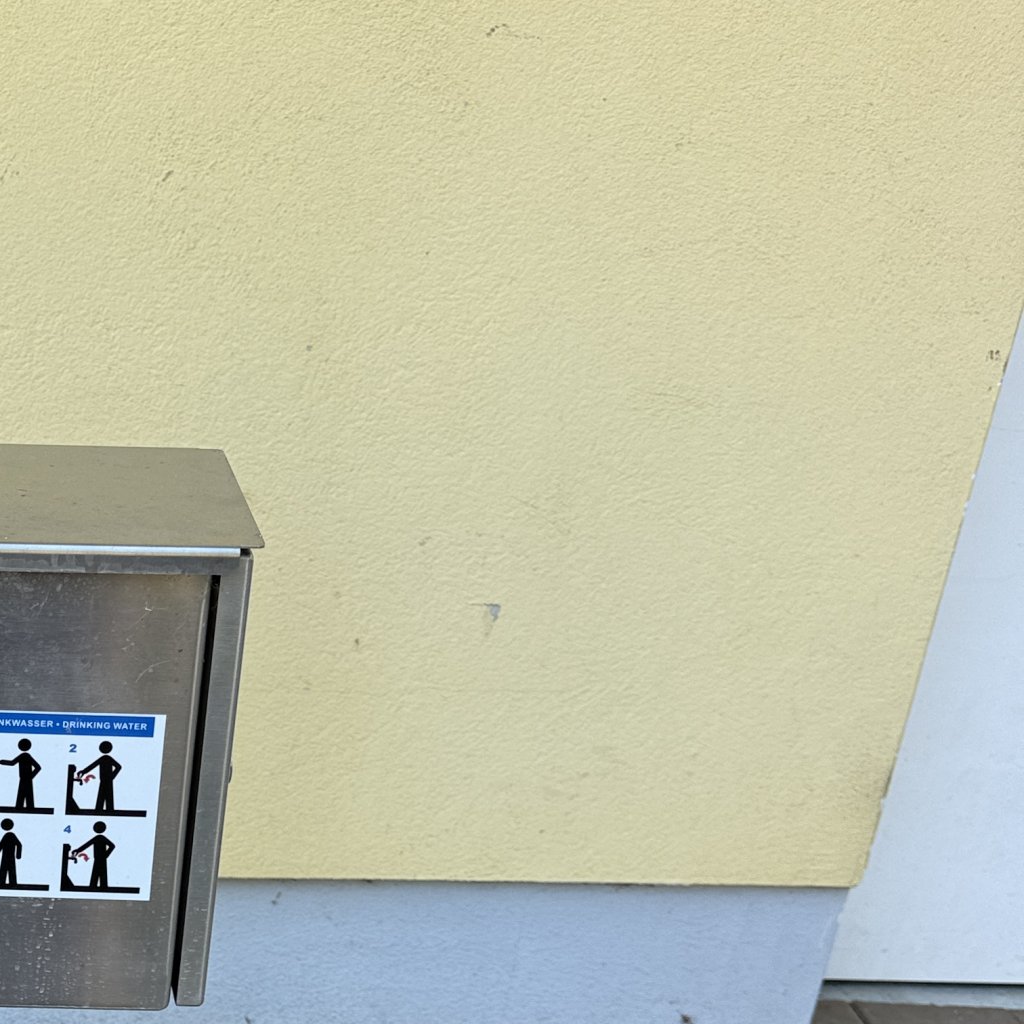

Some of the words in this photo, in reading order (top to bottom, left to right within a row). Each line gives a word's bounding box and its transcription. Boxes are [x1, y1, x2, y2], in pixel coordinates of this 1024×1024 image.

[62, 720, 111, 730] DRINKING
[113, 722, 148, 731] WATER
[68, 743, 77, 753] 2
[63, 825, 72, 834] 4
